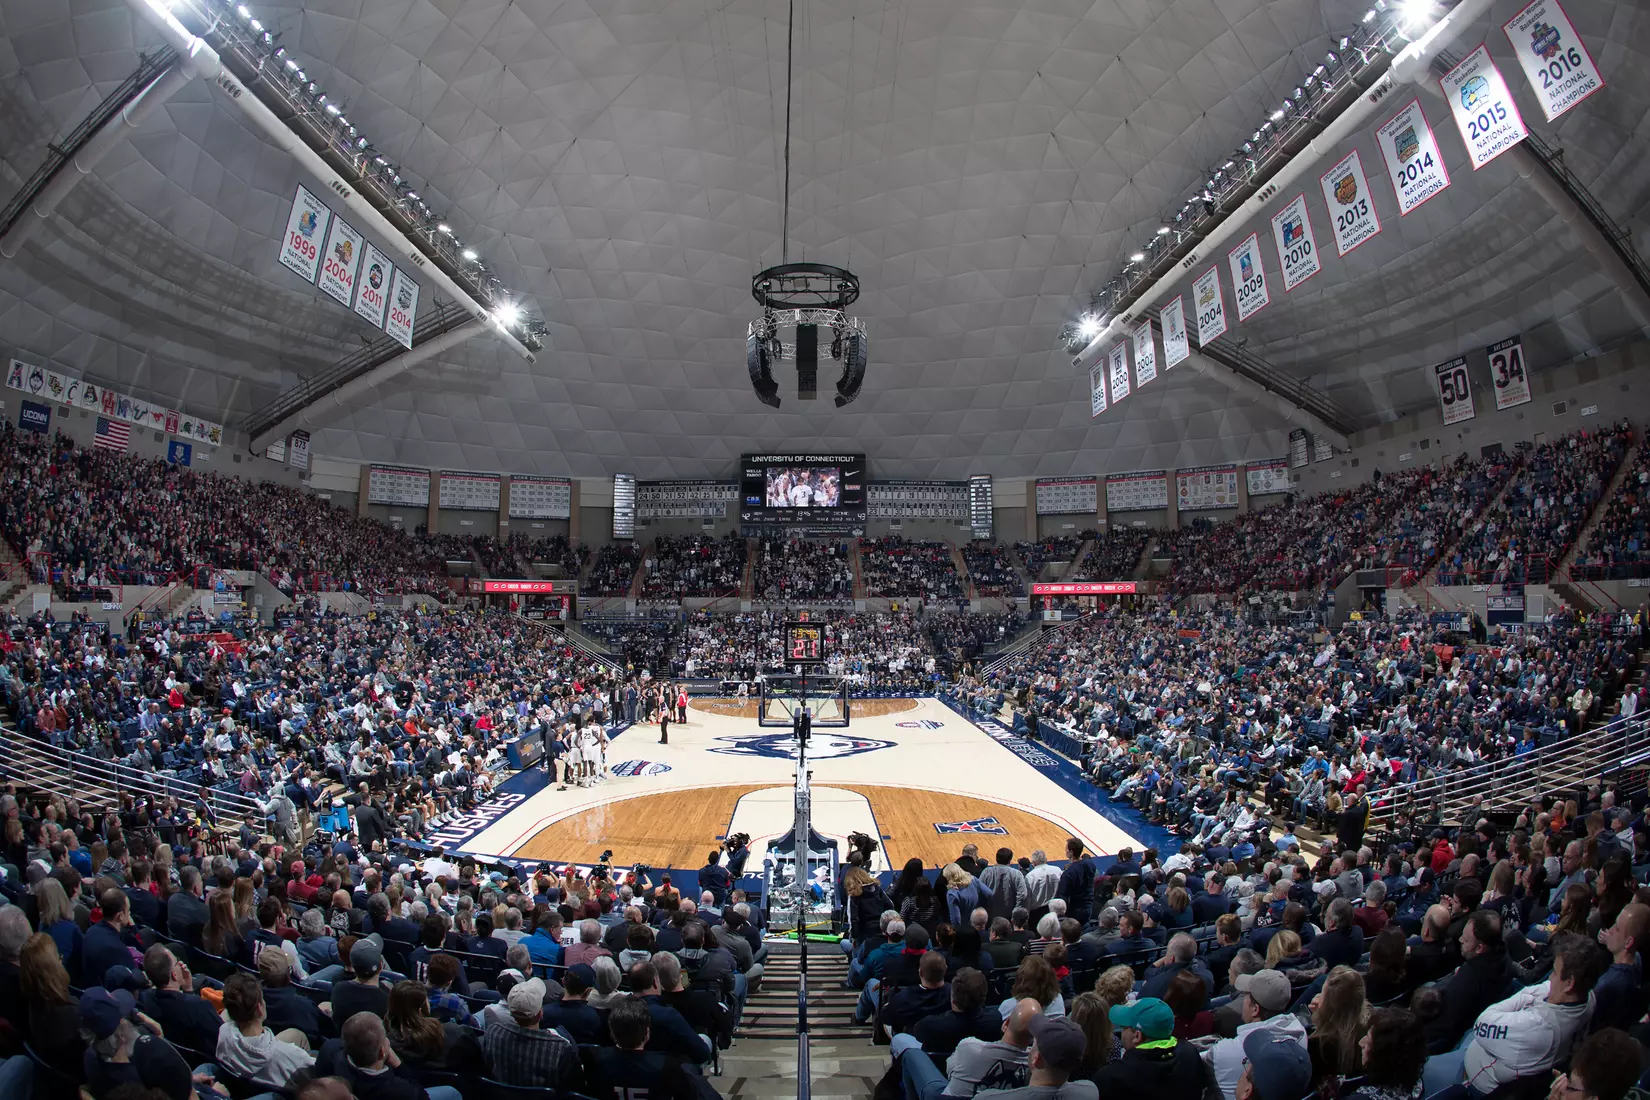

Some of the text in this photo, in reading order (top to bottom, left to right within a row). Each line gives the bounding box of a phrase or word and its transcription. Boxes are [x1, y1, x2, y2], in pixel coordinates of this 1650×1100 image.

[1508, 12, 1526, 29] UConn
[1520, 8, 1547, 32] Basketball
[1444, 50, 1482, 83] UConn Women's
[1454, 62, 1480, 85] Basketball
[1538, 47, 1582, 89] 2016
[1549, 70, 1588, 100] NATIONAL
[1552, 78, 1596, 112] CHAMPIONS
[1395, 104, 1416, 123] Women's
[1468, 101, 1506, 140] 2015
[1388, 116, 1412, 137] Basketball
[1476, 122, 1512, 150] NATIONAL
[1478, 130, 1520, 162] CHAMPIONS
[1398, 152, 1434, 188] 2014
[1404, 172, 1436, 197] NATIONAL
[1406, 180, 1442, 208] CHAMPIONS
[1337, 198, 1368, 232] 2013
[1342, 218, 1370, 240] NATIONAL
[1342, 226, 1375, 251] CHAMPIONS
[290, 231, 316, 260] 1999
[1284, 240, 1311, 270] 2010
[283, 256, 312, 280] CHAMPIONS
[287, 248, 311, 270] NATIONAL
[1288, 258, 1313, 278] NATIONAL
[325, 257, 353, 287] 2004
[1288, 264, 1317, 287] CHAMPIONS
[322, 282, 348, 304] CHAMPIONS
[326, 275, 347, 294] NATIONAL
[1238, 274, 1263, 302] 2009
[362, 285, 382, 309] 2011
[1242, 292, 1262, 308] NATIONAL
[1242, 297, 1266, 318] CHAMPIONS
[358, 307, 380, 326] CHAMPIONS
[391, 307, 411, 330] 2014
[1200, 303, 1222, 329] 2004
[1137, 354, 1153, 372] 2002
[1492, 348, 1524, 388] 34
[1113, 372, 1128, 390] 2000
[1440, 368, 1469, 405] 50
[23, 409, 48, 422] UCONN
[294, 439, 306, 450] 873
[1450, 621, 1460, 630] 110
[794, 640, 816, 659] 21
[423, 792, 526, 850] HUSKIES
